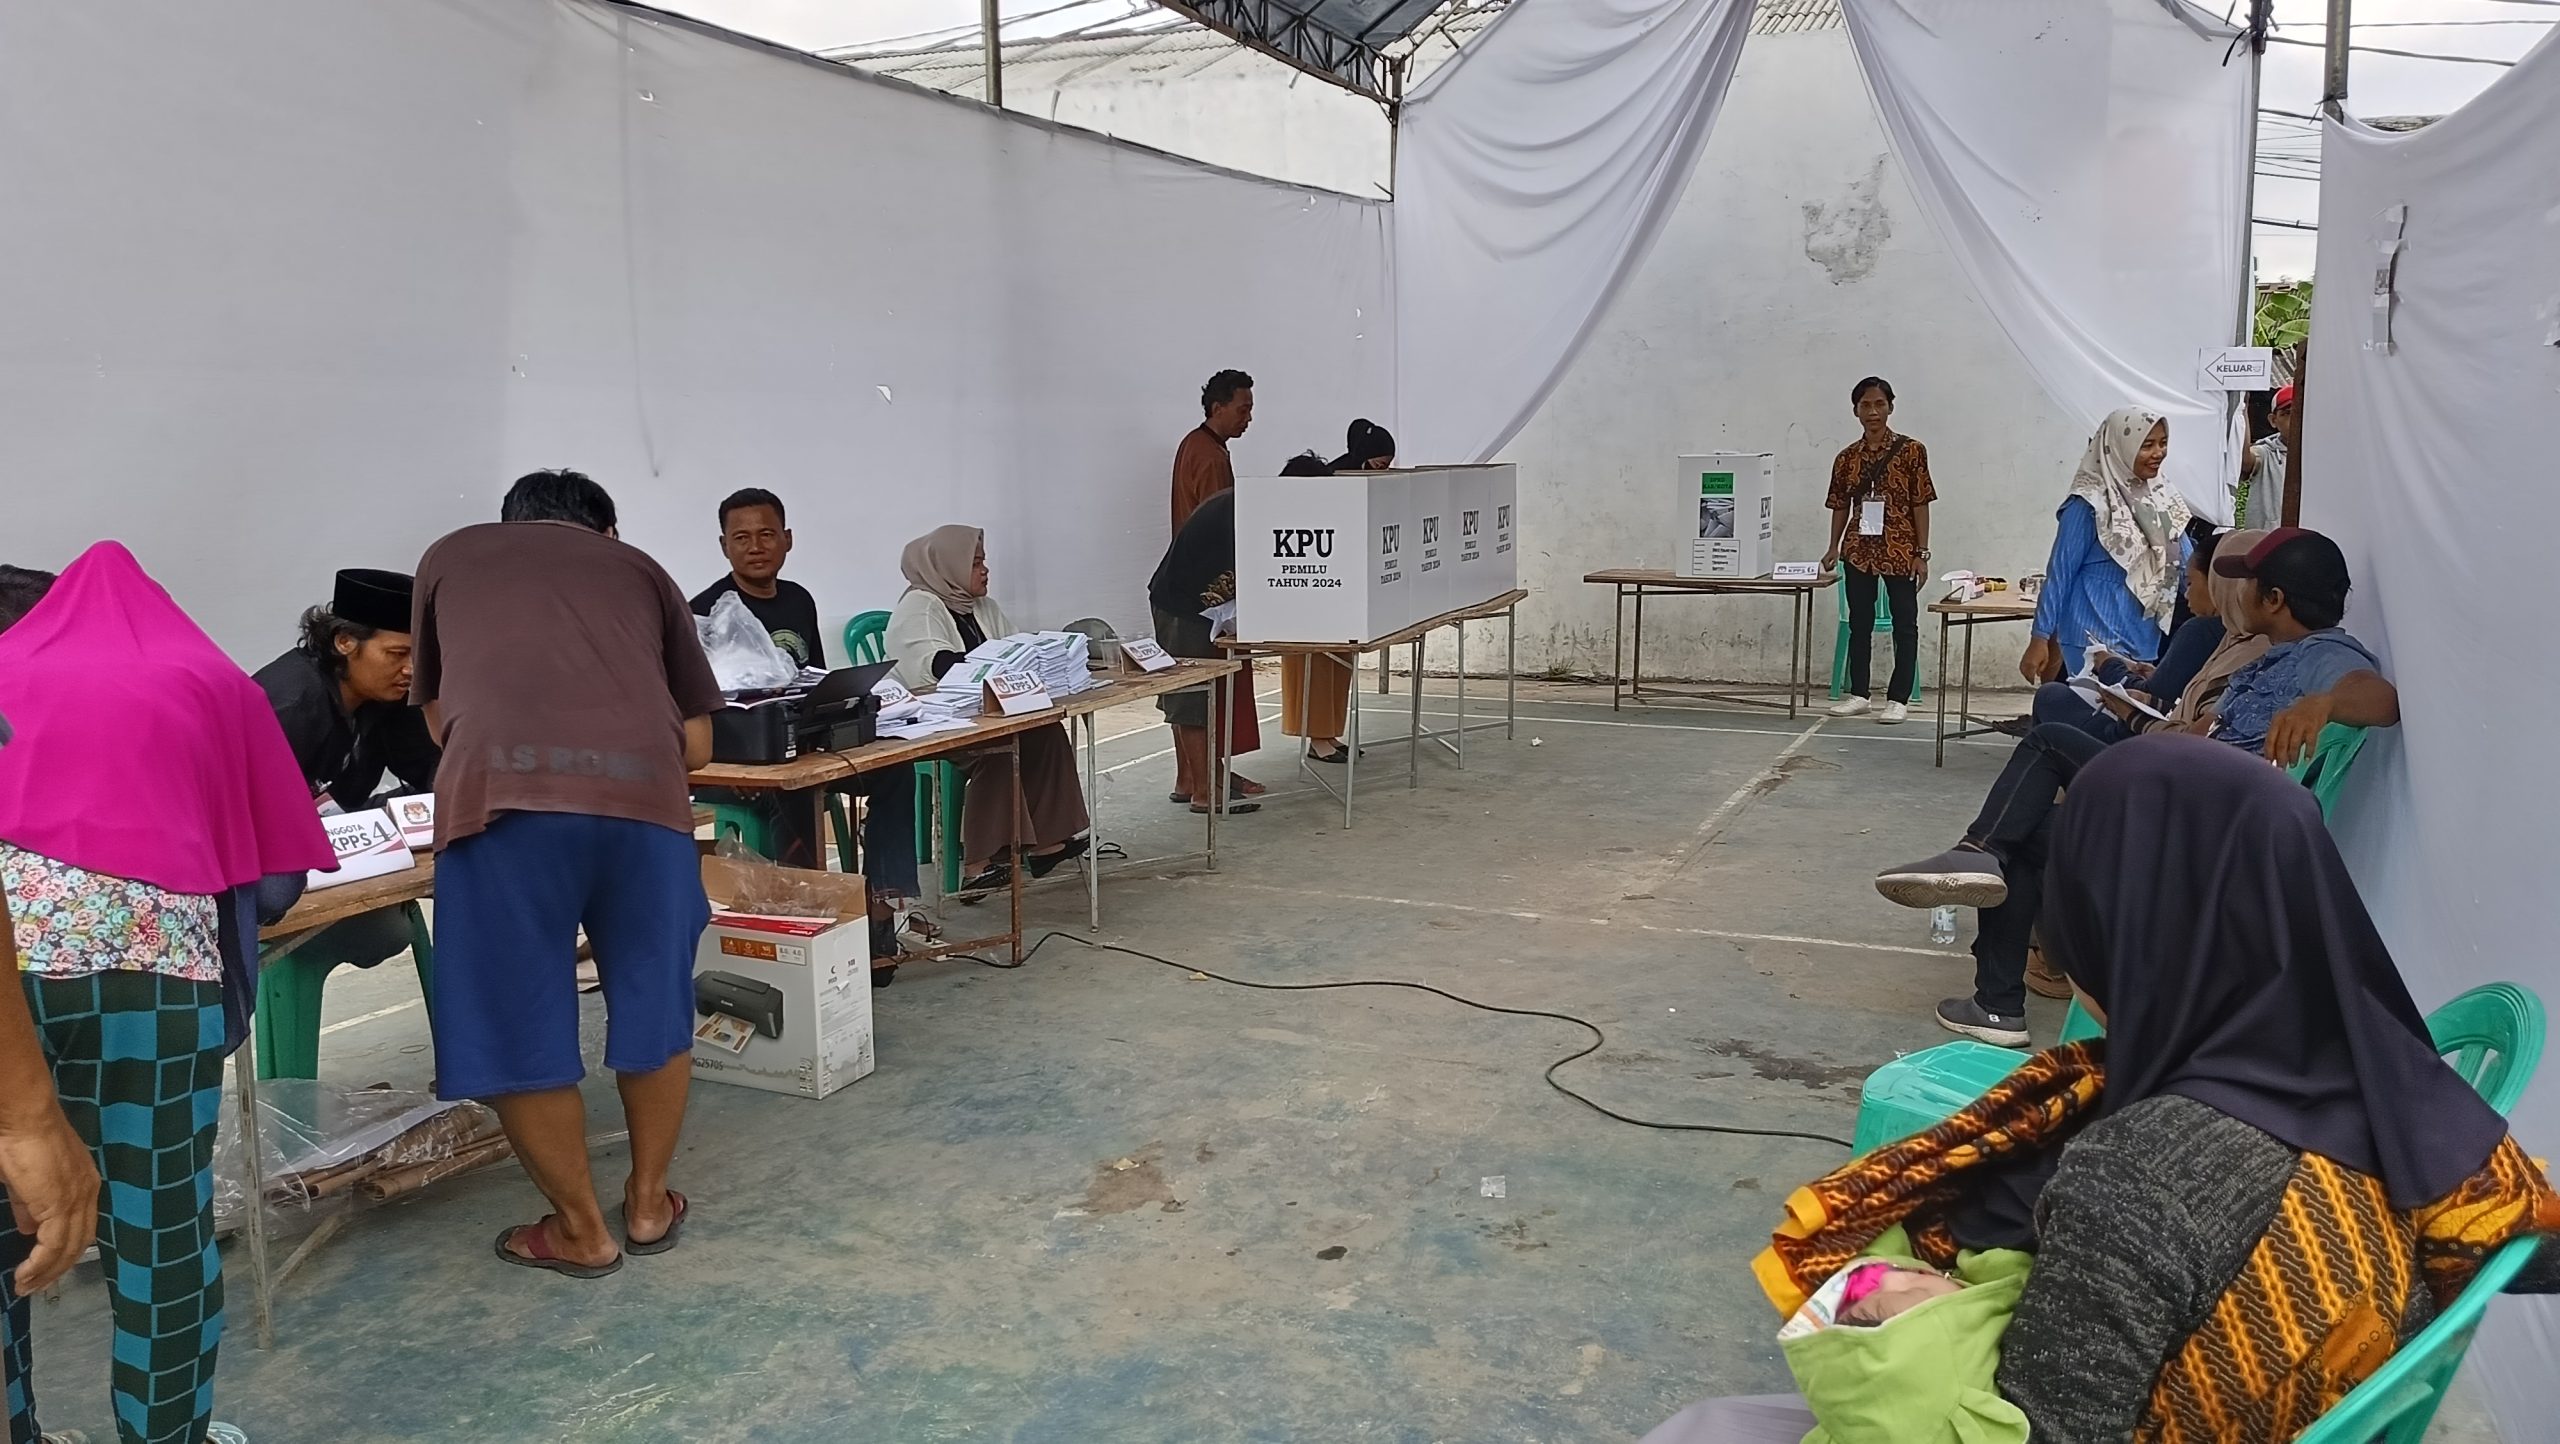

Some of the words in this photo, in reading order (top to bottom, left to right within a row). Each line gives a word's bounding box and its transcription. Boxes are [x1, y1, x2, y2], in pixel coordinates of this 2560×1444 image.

[2216, 364, 2253, 373] KELUAR
[1463, 510, 1479, 536] KPU
[1497, 504, 1510, 530] KPU
[1382, 524, 1400, 555] KPU
[1423, 516, 1439, 544] KPU
[1273, 529, 1335, 558] KPU
[1281, 564, 1327, 574] PEMILU
[1267, 578, 1309, 588] TAHUN
[1312, 578, 1342, 588] 2024
[1005, 673, 1026, 682] KETUA
[1010, 681, 1031, 691] KPPS
[373, 821, 393, 841] 4
